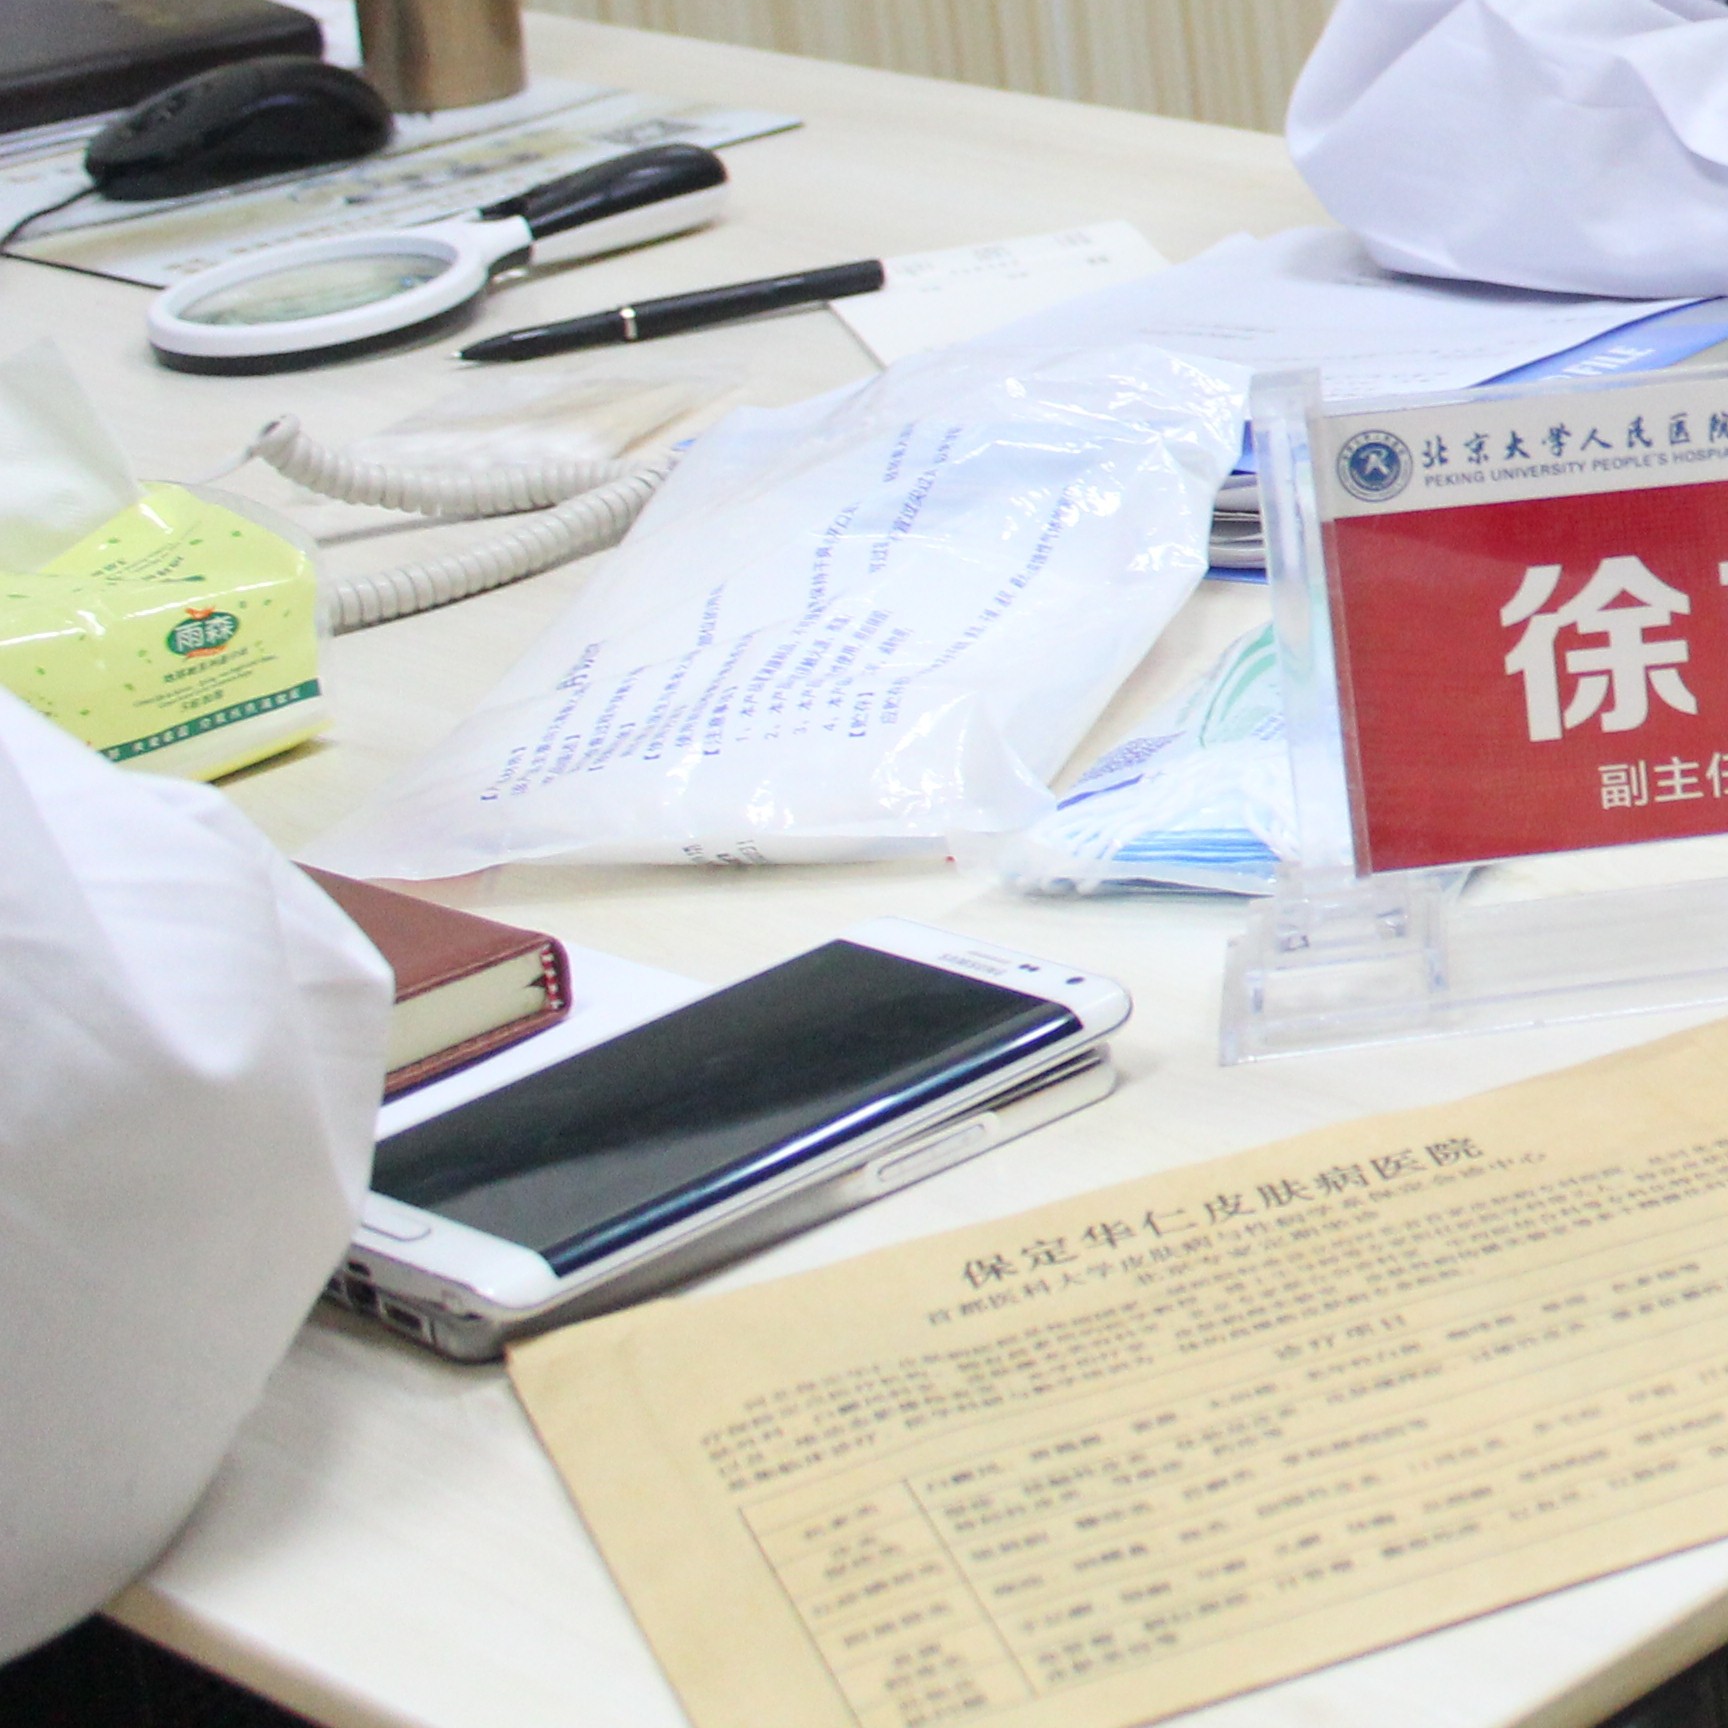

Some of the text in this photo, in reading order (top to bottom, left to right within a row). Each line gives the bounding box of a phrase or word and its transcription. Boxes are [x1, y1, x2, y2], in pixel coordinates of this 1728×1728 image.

[1424, 470, 1486, 488] PEKING
[1490, 460, 1587, 482] UNIVERSITY
[1592, 452, 1669, 472] PEOPLE'S
[959, 1135, 1485, 1291] 保定华仁皮肤病医院
